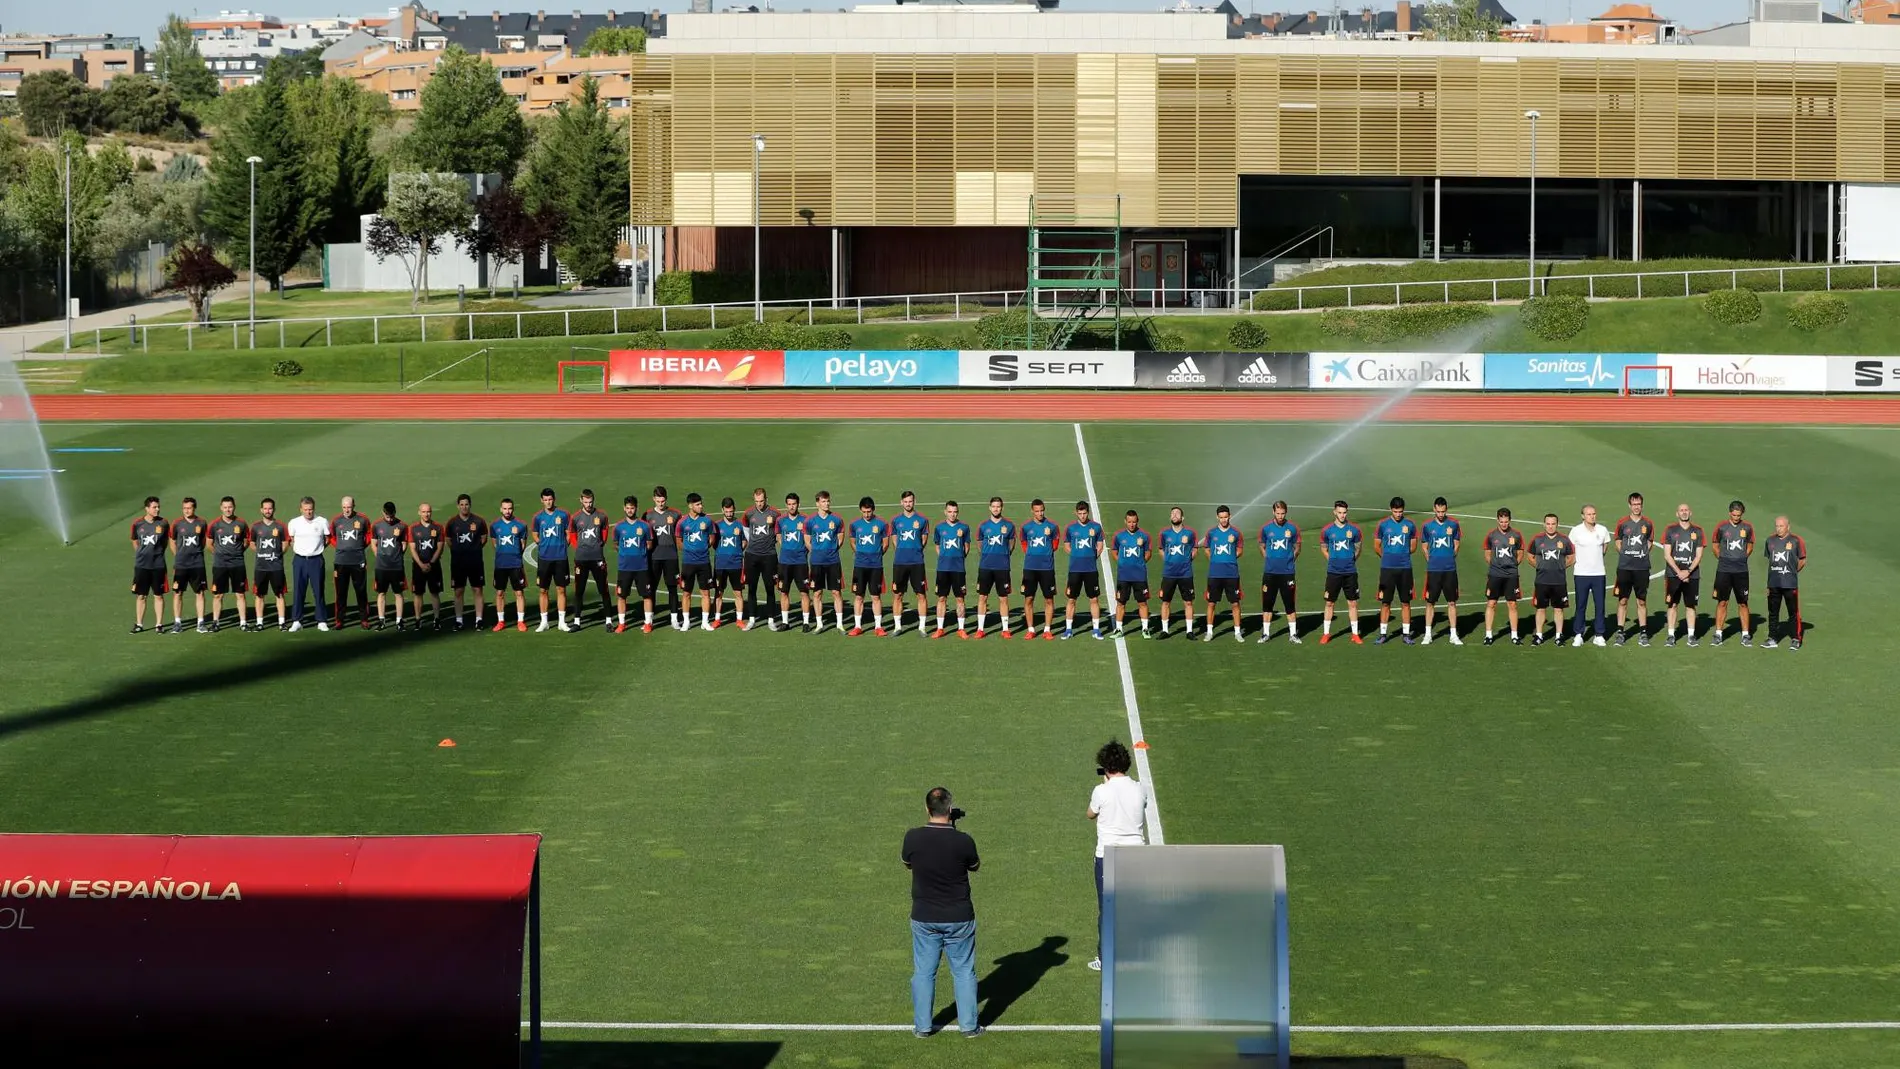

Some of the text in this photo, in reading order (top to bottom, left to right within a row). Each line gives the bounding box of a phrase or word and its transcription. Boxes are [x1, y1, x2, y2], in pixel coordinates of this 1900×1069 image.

[640, 357, 723, 372] IBERIA
[825, 353, 918, 383] pelayo
[1028, 362, 1104, 375] SEAT
[1357, 359, 1471, 382] CaixaBank
[1528, 358, 1587, 374] Sanitas
[1166, 373, 1206, 383] adidas
[1238, 373, 1277, 384] adidas
[1756, 376, 1786, 388] viajes
[0, 875, 242, 901] IÓN ESPAÑOLA
